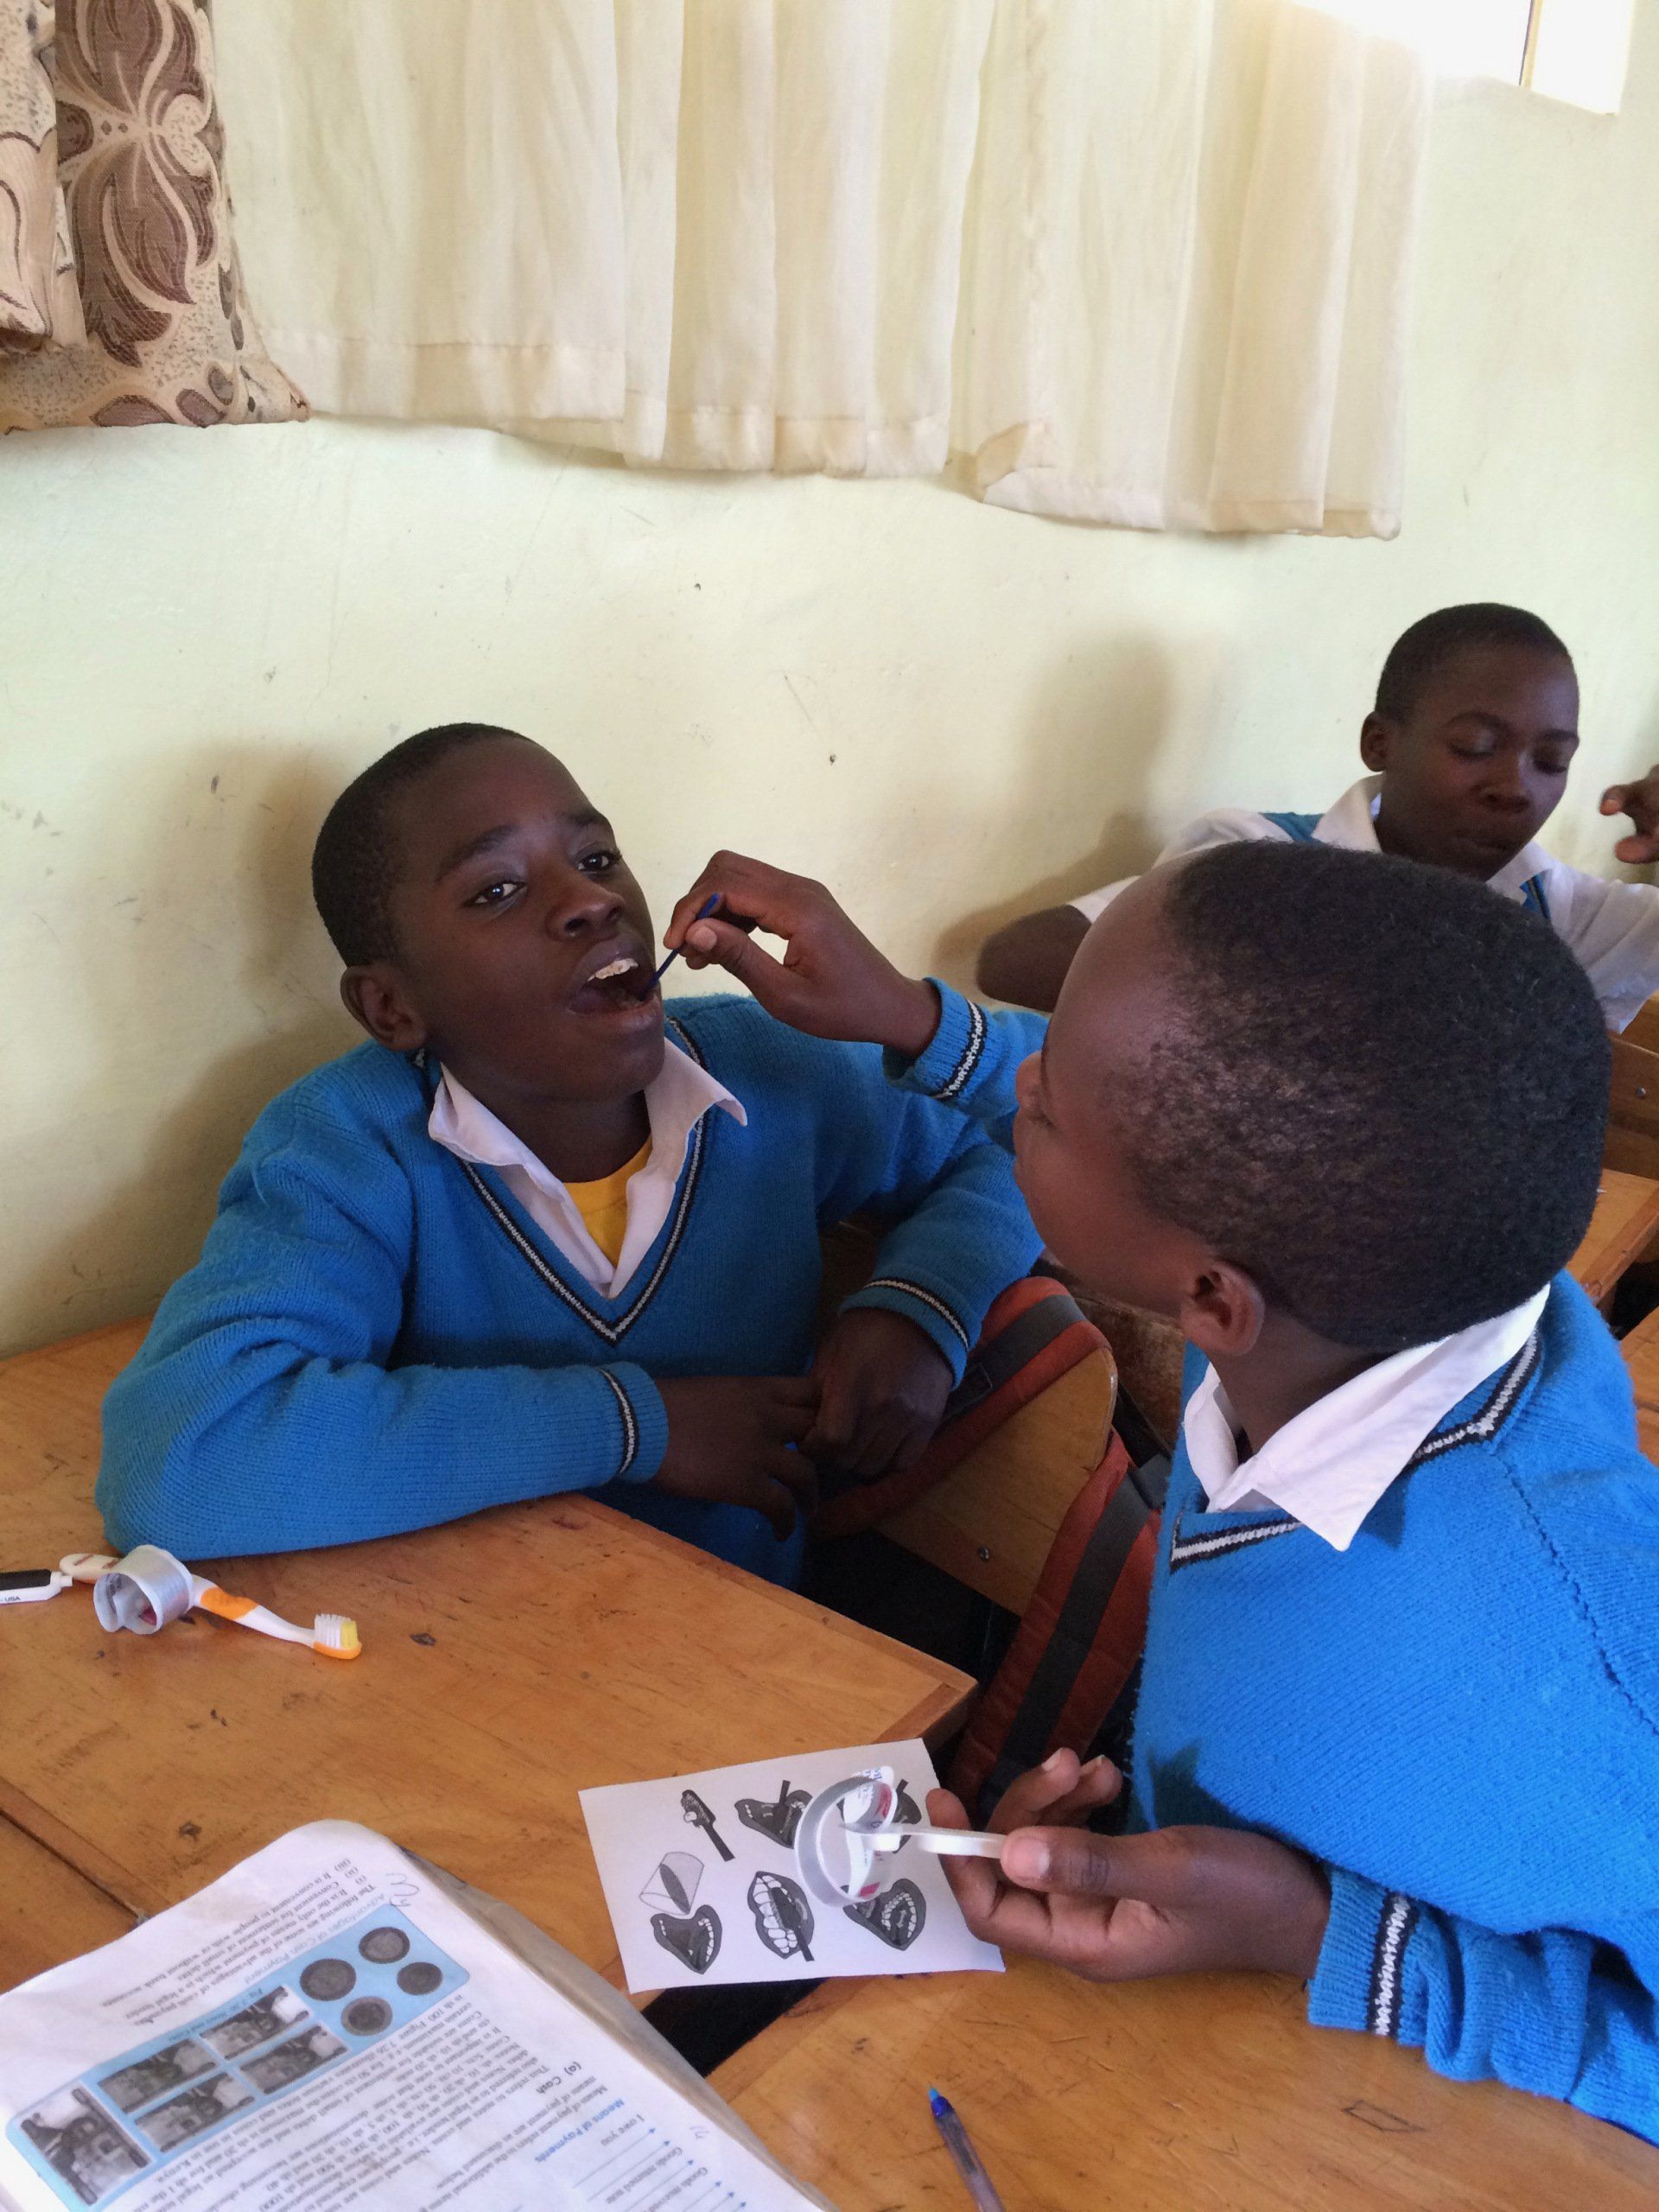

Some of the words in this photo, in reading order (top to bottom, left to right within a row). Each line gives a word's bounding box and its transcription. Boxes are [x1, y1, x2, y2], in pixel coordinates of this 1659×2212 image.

[269, 1882, 315, 1913] convenient
[318, 1894, 359, 1921] following
[236, 1917, 280, 1945] settlement
[269, 1919, 296, 1937] means
[165, 1953, 200, 1975] without
[200, 1948, 226, 1967] small
[221, 1940, 260, 1966] payment
[194, 1964, 223, 1983] which
[209, 1955, 257, 1986] advantages
[154, 1990, 179, 2008] legal
[124, 2002, 155, 2020] tender
[442, 2001, 473, 2023] certain
[455, 2010, 483, 2029] Coins
[397, 2020, 427, 2040] Figure
[410, 2036, 444, 2058] suitable
[442, 2038, 484, 2065] important
[334, 2051, 377, 2078] illustrates
[479, 2064, 506, 2083] Notes
[563, 2061, 582, 2075] (a)
[301, 2076, 334, 2098] various
[353, 2065, 397, 2094] settlement
[487, 2067, 523, 2092] referred
[504, 2076, 531, 2094] refers
[534, 2075, 563, 2094] Cash
[569, 2075, 597, 2094] means
[276, 2094, 302, 2111] notes
[319, 2083, 345, 2101] coins
[440, 2091, 465, 2107] coins
[579, 2084, 608, 2104] Means
[316, 2098, 343, 2117] small
[447, 2101, 472, 2120] legal
[471, 2100, 496, 2118] notes
[524, 2097, 563, 2126] payment
[590, 2098, 626, 2122] Means
[232, 2118, 258, 2135] coins
[257, 2106, 305, 2135] maximum
[291, 2113, 318, 2131] debts
[303, 2109, 370, 2152] denominations
[386, 2116, 429, 2145] available
[536, 2106, 573, 2133] payment
[514, 2130, 541, 2149] refers
[532, 2127, 584, 2163] Payments
[213, 2146, 257, 2177] accepted
[342, 2150, 378, 2172] various
[402, 2146, 430, 2165] Notes
[461, 2140, 504, 2171] discussed
[654, 2145, 683, 2167] Goods
[238, 2158, 289, 2192] becoming
[358, 2175, 385, 2193] coins
[450, 2161, 496, 2196] additional
[621, 2164, 658, 2192] returned
[175, 2182, 204, 2203] legal
[314, 2176, 358, 2207] expected
[427, 2191, 454, 2210] items
